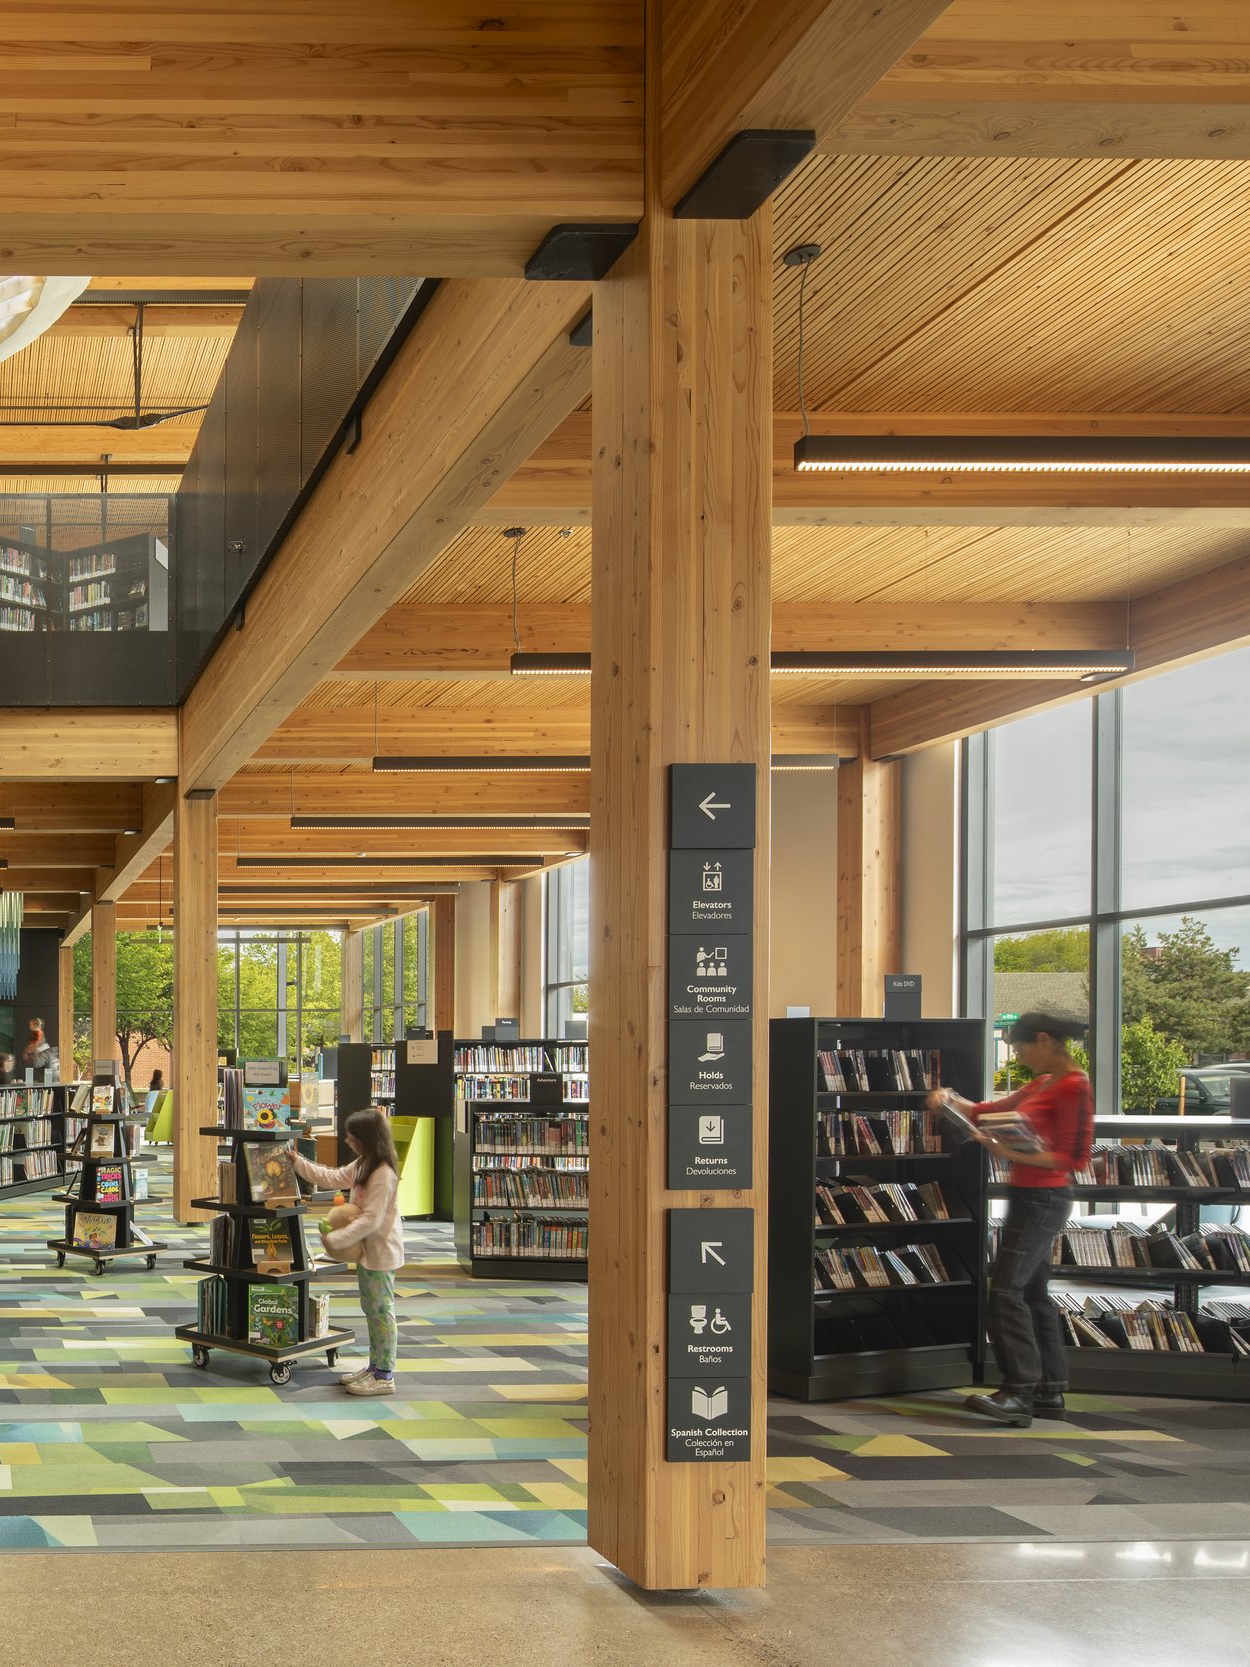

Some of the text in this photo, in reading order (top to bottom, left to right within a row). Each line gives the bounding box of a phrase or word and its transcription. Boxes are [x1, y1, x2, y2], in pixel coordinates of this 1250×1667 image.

[692, 900, 732, 909] Elevators
[692, 911, 732, 920] Elevadores
[686, 984, 737, 995] Community
[697, 994, 727, 1003] Rooms
[673, 1004, 750, 1014] Salas de Comunidad
[698, 1071, 724, 1080] Holds
[689, 1081, 733, 1090] Reservados
[252, 1102, 282, 1111] Flower
[694, 1156, 728, 1165] Returns
[686, 1166, 737, 1176] Devoluciones
[253, 1304, 293, 1314] Gardens
[687, 1344, 734, 1353] Restrooms
[699, 1354, 722, 1364] Baños
[670, 1428, 749, 1439] Spanish Collection
[684, 1437, 723, 1447] Colección
[695, 1447, 724, 1458] Español
